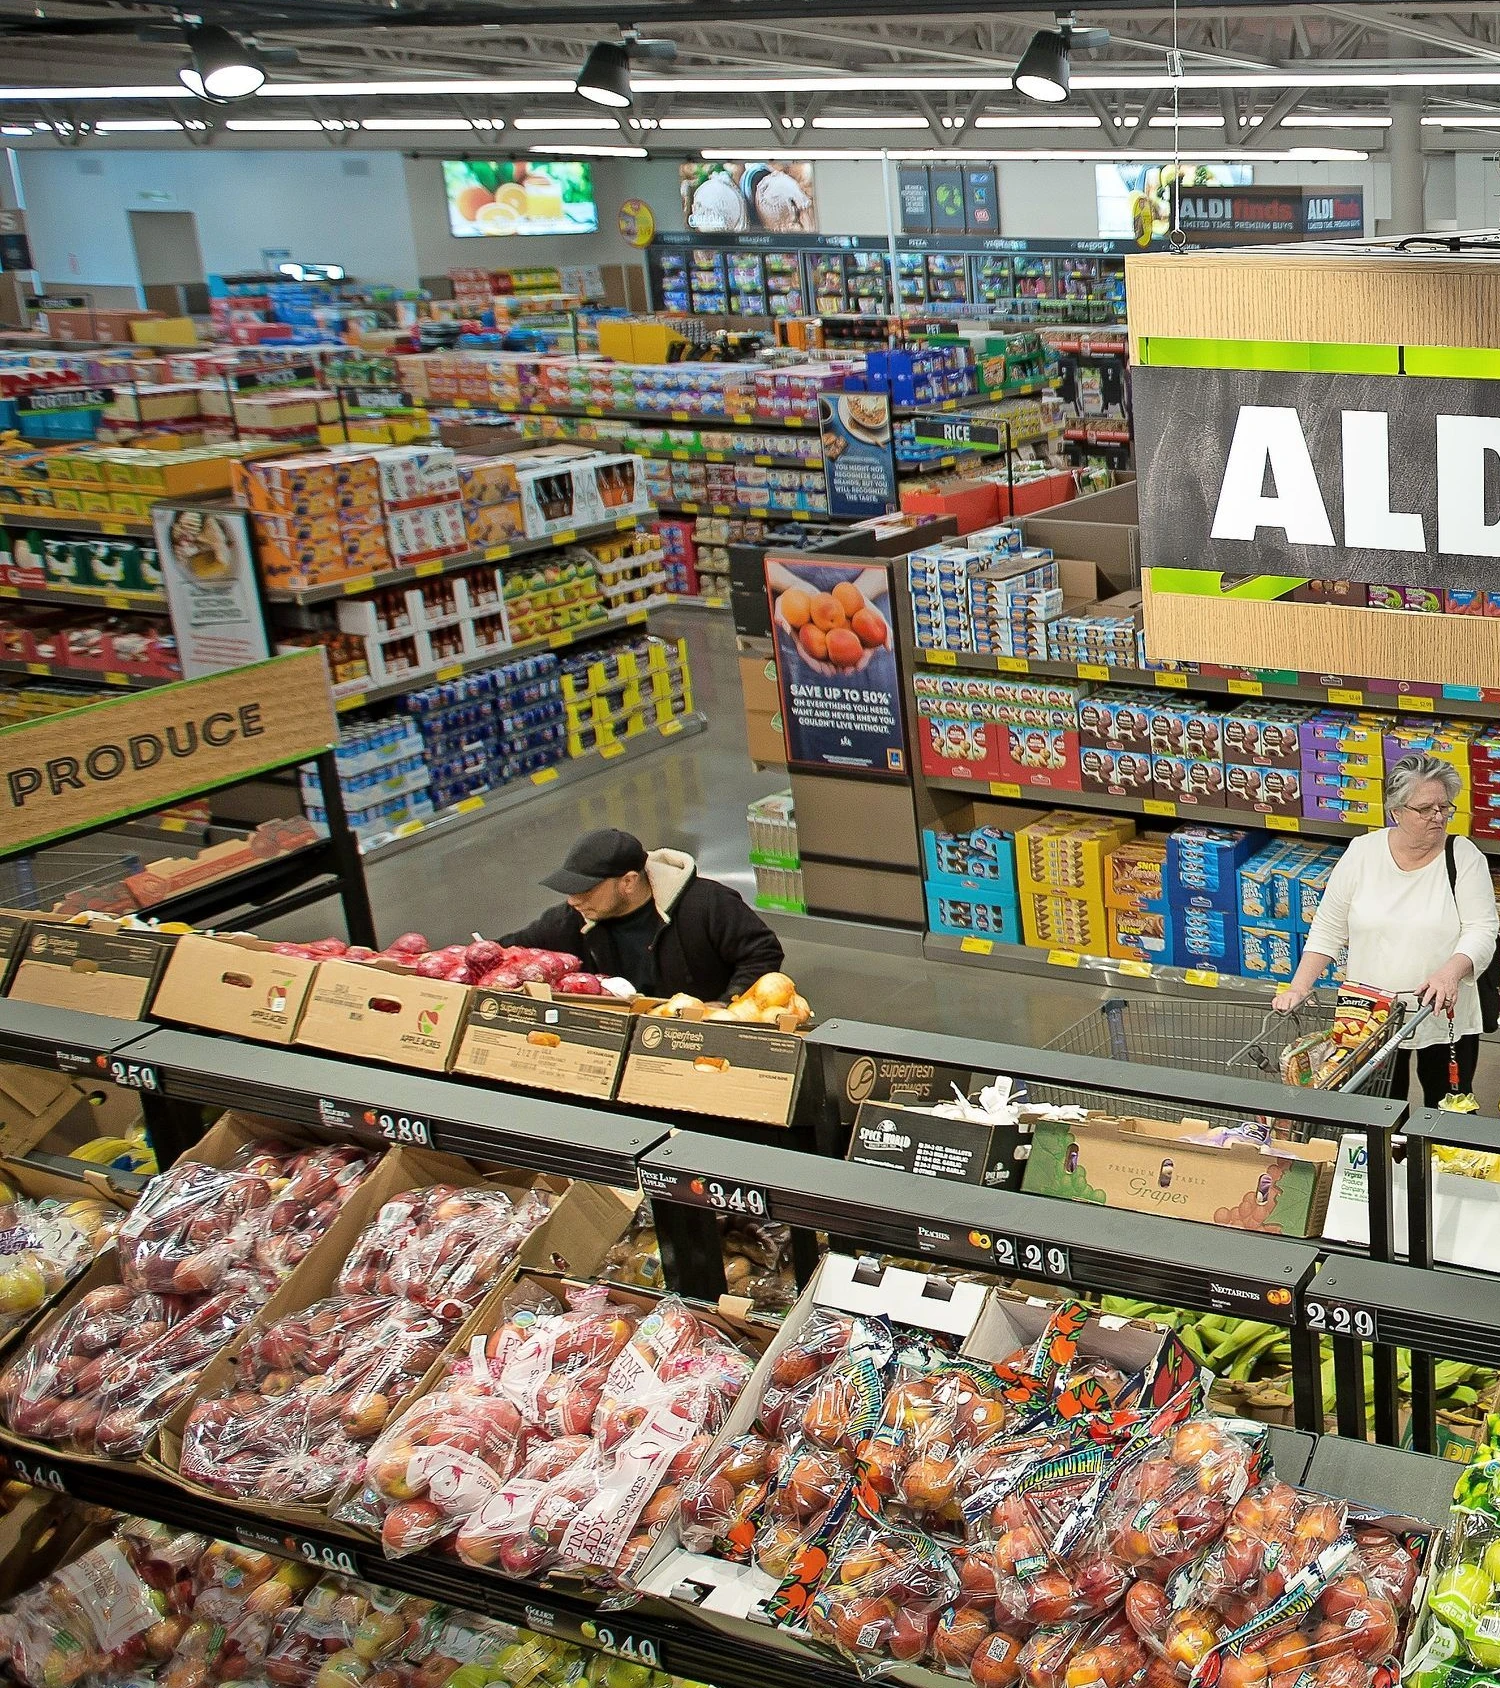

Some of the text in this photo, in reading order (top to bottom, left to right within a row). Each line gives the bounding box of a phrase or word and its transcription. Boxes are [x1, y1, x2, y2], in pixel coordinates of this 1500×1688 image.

[926, 324, 940, 334] PET
[943, 424, 970, 442] RICE
[790, 684, 822, 699] SAVE
[824, 687, 840, 700] UP
[843, 688, 860, 702] TO
[794, 698, 806, 707] ON
[805, 700, 852, 711] EVERYTHING
[853, 703, 868, 713] YOU
[792, 707, 896, 726] WANT AND NEVER KNEW YOU
[836, 721, 853, 731] LIVE
[7, 703, 265, 807] PRODUCE
[1137, 861, 1159, 871] BUNS
[1118, 925, 1141, 935] BUNS
[664, 1029, 704, 1042] superfresh
[671, 1040, 704, 1051] growers
[859, 1127, 912, 1149] SPICE WORLD
[1347, 1145, 1368, 1169] vp
[640, 1169, 678, 1184] PINK LADY
[1108, 1164, 1207, 1186] PREMIUM TABLE
[1342, 1177, 1364, 1187] Produce
[1343, 1170, 1363, 1180] Virginia
[1126, 1177, 1189, 1208] Grapes
[1341, 1184, 1366, 1195] Company
[918, 1227, 950, 1241] PEACHES
[996, 1238, 1066, 1275] 2.29
[1210, 1283, 1261, 1301] NECTARINES
[1306, 1302, 1374, 1338] 2.29
[1015, 1446, 1107, 1498] MOONLIGHT
